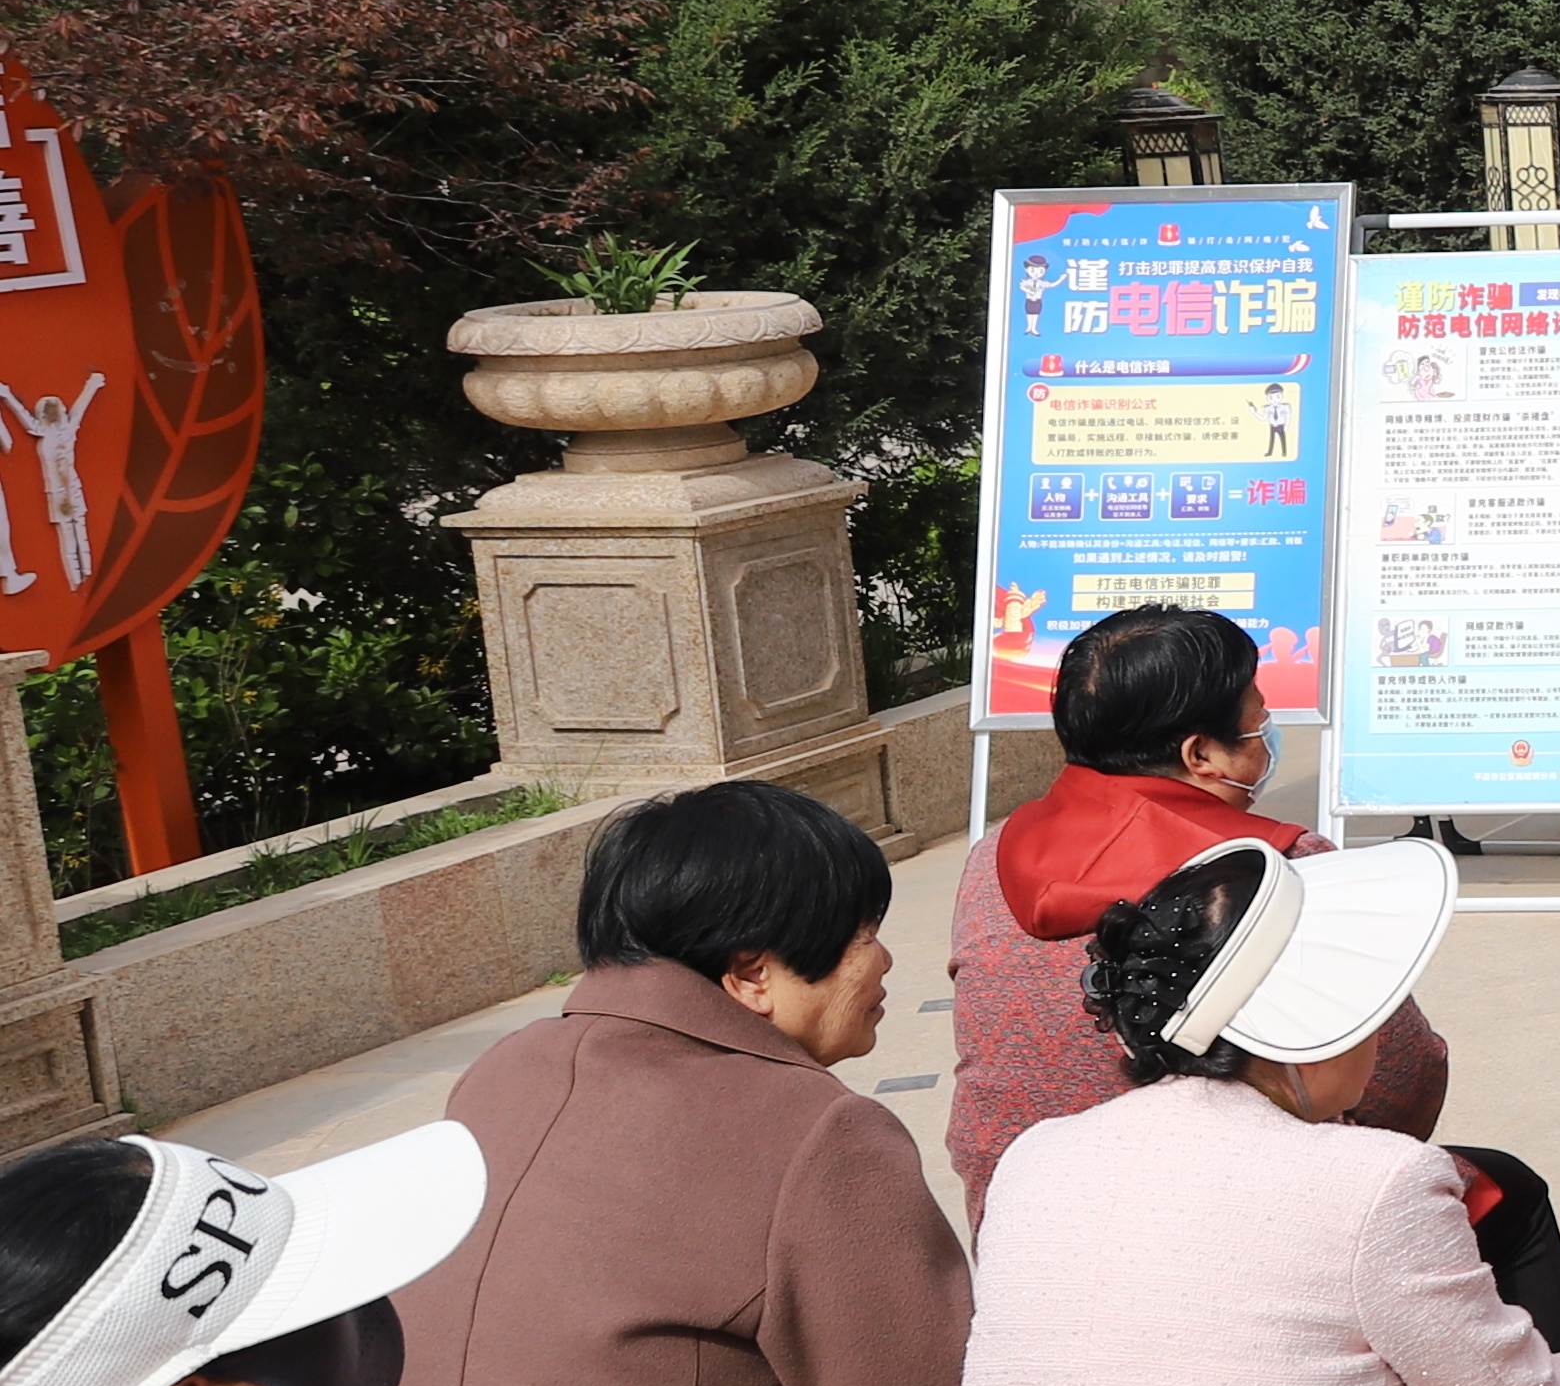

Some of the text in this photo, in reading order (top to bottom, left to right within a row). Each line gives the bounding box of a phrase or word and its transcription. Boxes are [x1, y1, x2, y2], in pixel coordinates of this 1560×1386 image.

[1118, 258, 1314, 277] 打击犯罪提高意识保护自我
[1396, 281, 1513, 313] 谨防诈骗
[1110, 278, 1317, 336] 电信诈骗
[1075, 360, 1170, 374] 什么是电信诈骗
[1032, 387, 1046, 399] 防
[1050, 398, 1157, 411] 电信诈骗识别公式
[1246, 478, 1307, 505] 诈骗
[1097, 576, 1221, 590] 打击电信诈骗犯罪
[1096, 594, 1220, 609] 构建平安和谐社会
